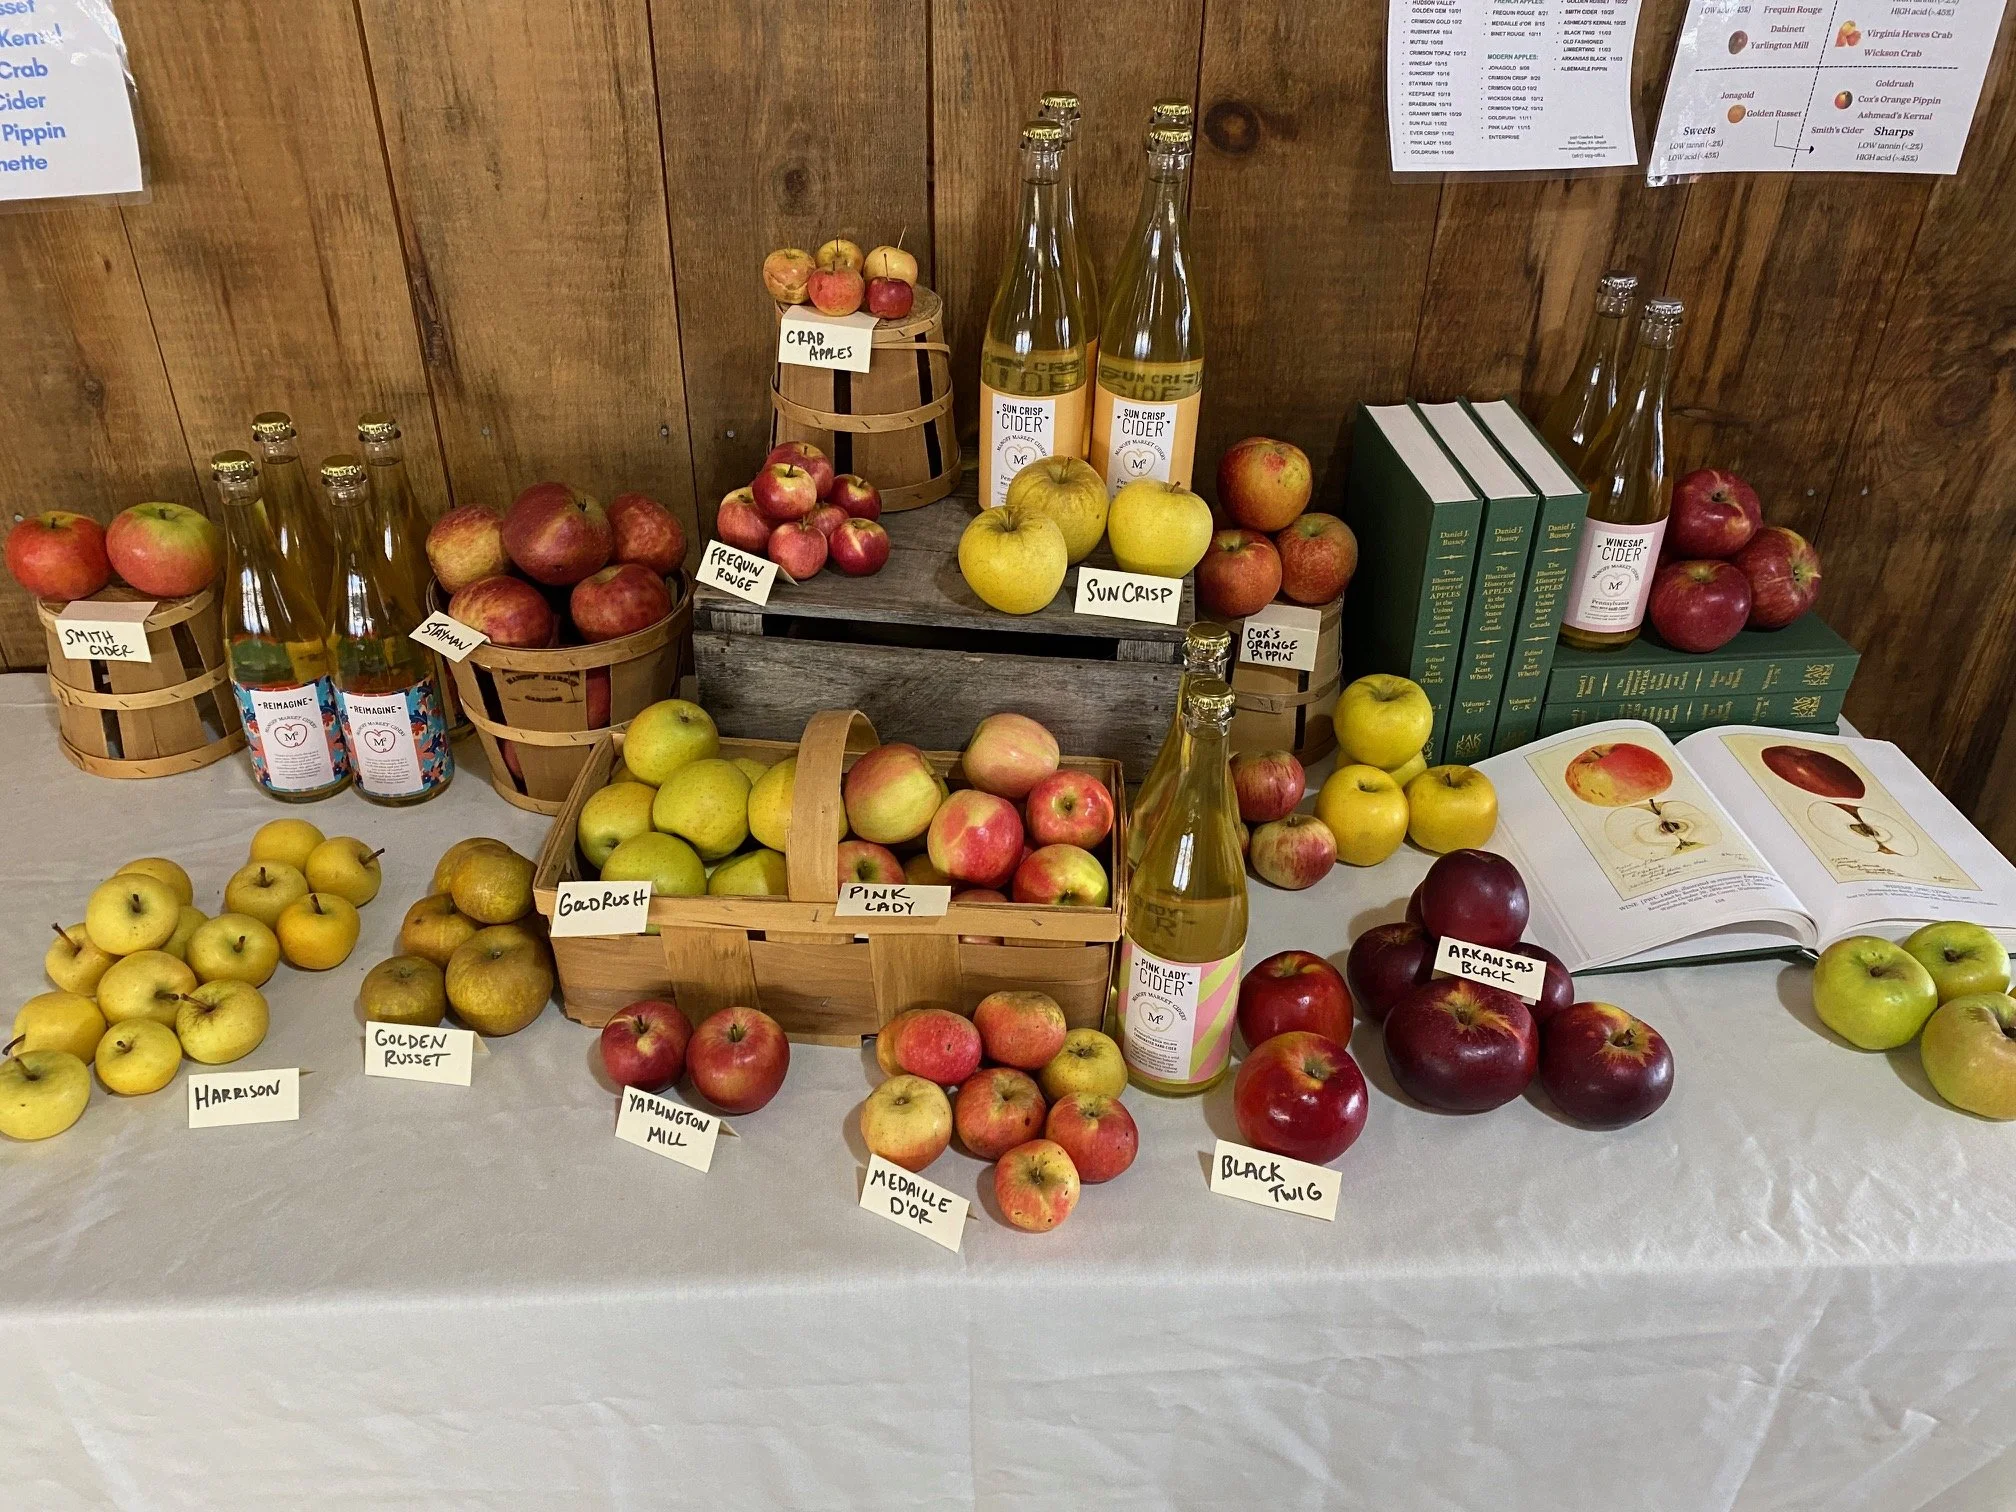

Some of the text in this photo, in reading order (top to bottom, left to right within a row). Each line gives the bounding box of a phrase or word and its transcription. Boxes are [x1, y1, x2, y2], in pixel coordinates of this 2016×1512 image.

[1764, 6, 1822, 15] Frequin Rouge
[1867, 30, 1900, 39] Virginia
[1751, 42, 1792, 50] Yarlington
[0, 57, 48, 79] Crab
[1876, 80, 1914, 88] Goldrush
[1721, 91, 1754, 100] Jonagold
[1880, 96, 1912, 105] Orange
[1913, 97, 1941, 105] Pippin
[1858, 112, 1902, 120] Ashmead's
[2, 121, 66, 146] Pippin
[1683, 126, 1716, 135] Sweets
[1874, 126, 1914, 138] Sharps
[786, 330, 824, 345] CRAB
[810, 345, 852, 361] APPLES
[1002, 404, 1043, 416] SUN CRISP
[1124, 408, 1165, 420] SUN CRISP
[1002, 413, 1043, 432] CIDER
[1122, 418, 1164, 437] CIDER
[1012, 435, 1034, 443] MARKET
[1034, 440, 1047, 457] CIDERY
[1606, 538, 1644, 547] WINESAP
[710, 547, 764, 577] FREQUIN
[1602, 546, 1642, 562] CIDER
[716, 568, 758, 591] ROUGE
[1482, 588, 1513, 596] APPLES
[1534, 584, 1563, 592] APPLES
[65, 629, 114, 645] SMITH
[421, 622, 472, 651] STAYMAN
[90, 644, 134, 657] CIDER
[1247, 640, 1298, 651] ORANGE
[263, 698, 308, 710] REIMAGINE
[354, 706, 396, 715] REIMAGINE
[849, 886, 911, 900] PINK
[864, 901, 918, 915] LADY
[1141, 958, 1160, 974] PINK
[1448, 945, 1534, 972] ARKANSAS
[1461, 961, 1514, 983] BLACK
[1140, 968, 1184, 996] CIDER
[1148, 992, 1173, 1004] MARKET
[375, 1029, 448, 1049] GOLDEN
[385, 1050, 451, 1068] RUSSET
[195, 1080, 280, 1110] HARRISON
[630, 1094, 710, 1132] YARLINGTON
[647, 1126, 687, 1146] MILL
[1222, 1155, 1286, 1182] BLACK
[870, 1170, 952, 1213] MEDAILLE
[1268, 1182, 1322, 1202] TWIG
[890, 1197, 933, 1224] D'OR
